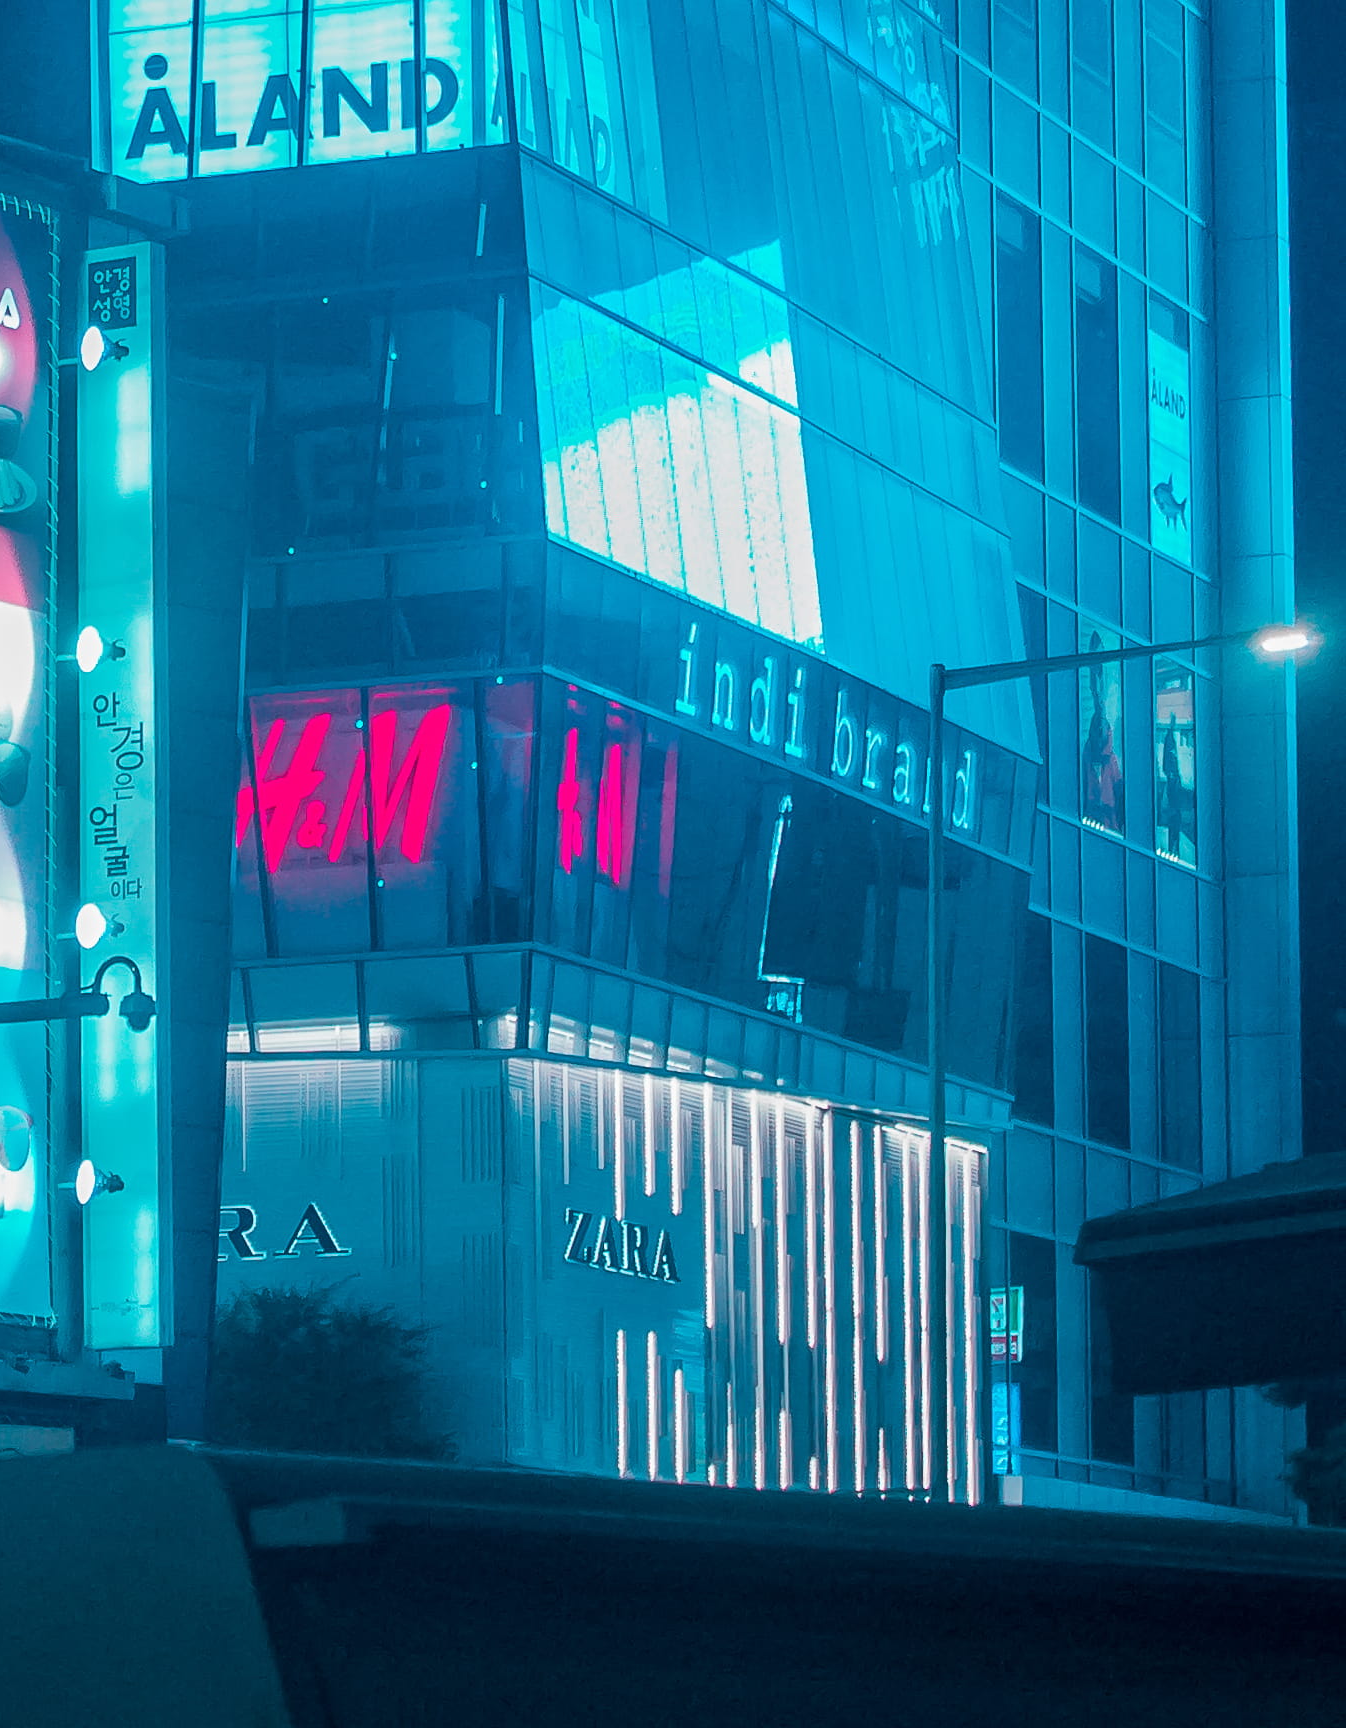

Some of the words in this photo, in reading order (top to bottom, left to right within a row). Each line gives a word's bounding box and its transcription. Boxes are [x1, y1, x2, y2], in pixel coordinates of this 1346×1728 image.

[92, 289, 130, 323] 성형
[93, 265, 130, 294] 안경
[674, 622, 805, 759] indi
[92, 691, 145, 802] 안경은
[234, 703, 452, 875] H&M
[89, 803, 143, 901] 얼굴이다
[563, 1206, 682, 1285] ZARA
